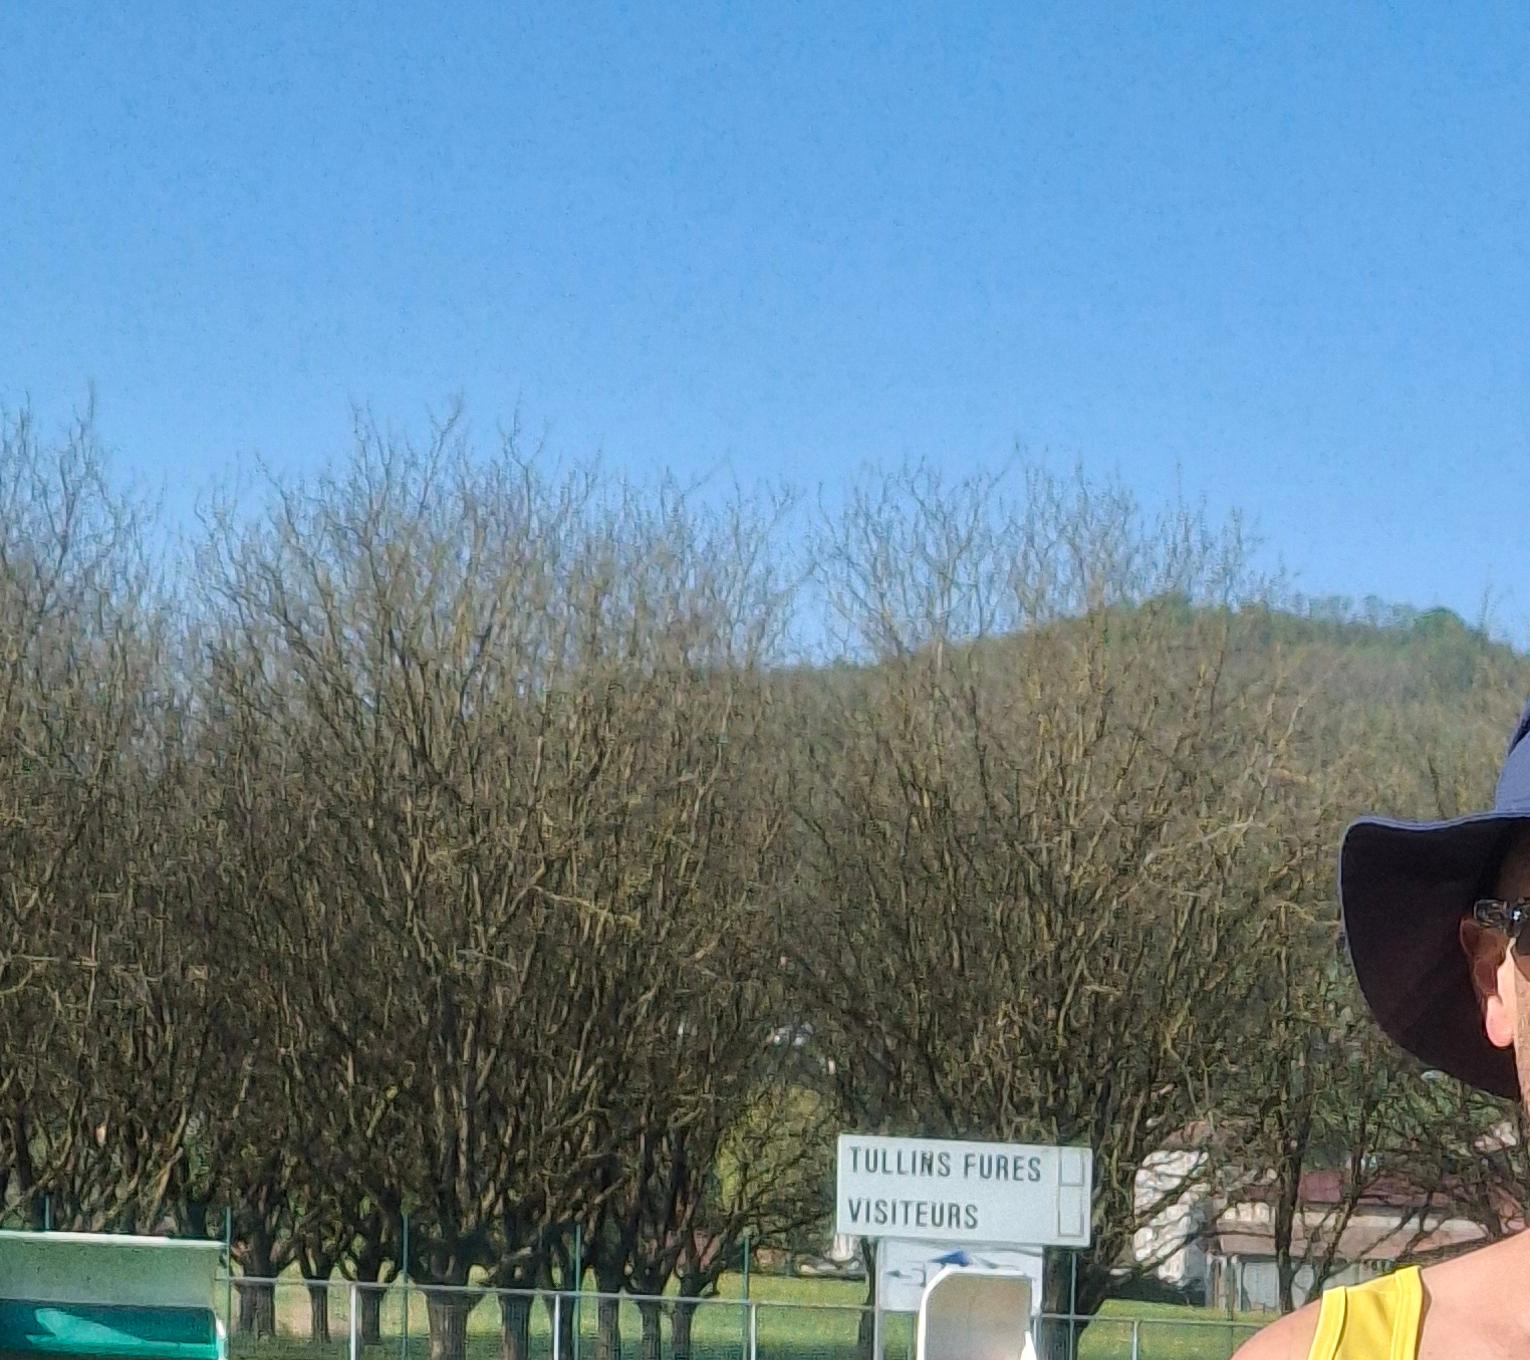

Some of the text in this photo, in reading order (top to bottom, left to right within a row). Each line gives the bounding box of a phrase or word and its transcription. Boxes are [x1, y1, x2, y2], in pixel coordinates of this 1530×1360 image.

[849, 1145, 1042, 1183] TULLINS FURES
[847, 1198, 979, 1230] VISITEURS
